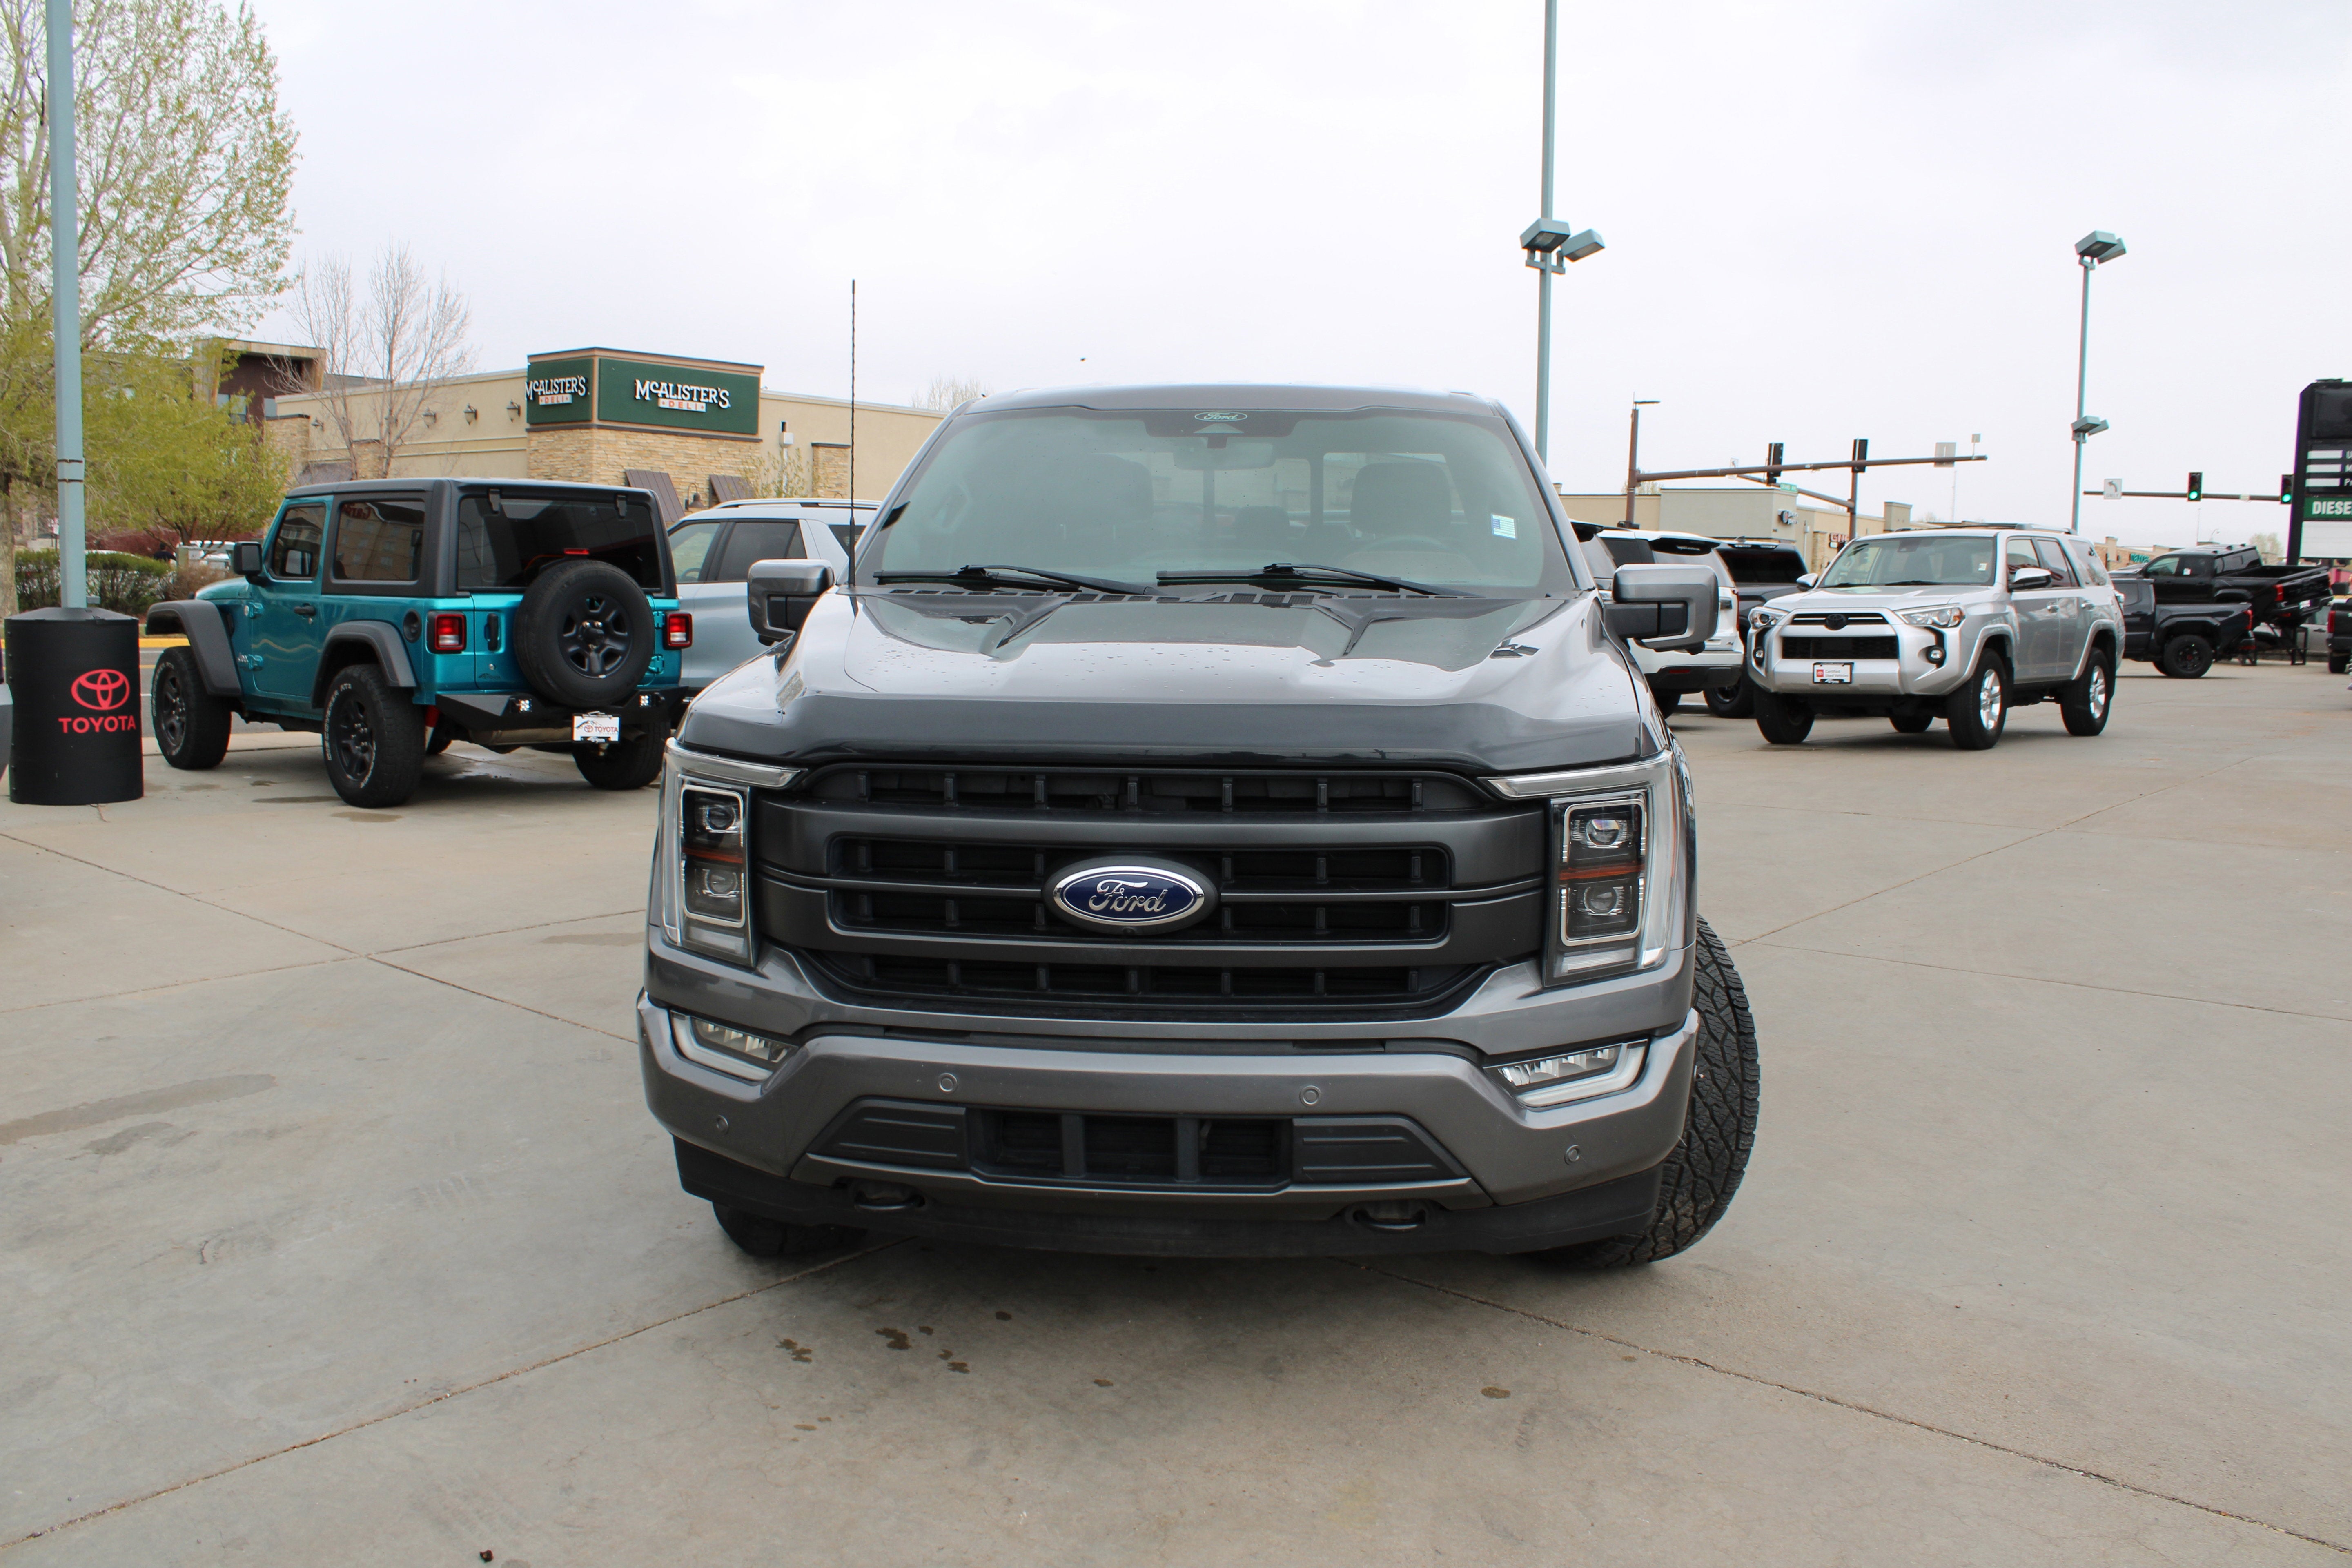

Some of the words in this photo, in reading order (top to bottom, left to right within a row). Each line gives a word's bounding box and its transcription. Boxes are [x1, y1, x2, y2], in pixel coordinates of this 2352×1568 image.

[545, 396, 564, 404] DELI
[668, 400, 698, 410] DELI
[2312, 501, 2352, 515] DIESE
[58, 715, 136, 733] TOYOTA
[1088, 879, 1168, 912] Ford
